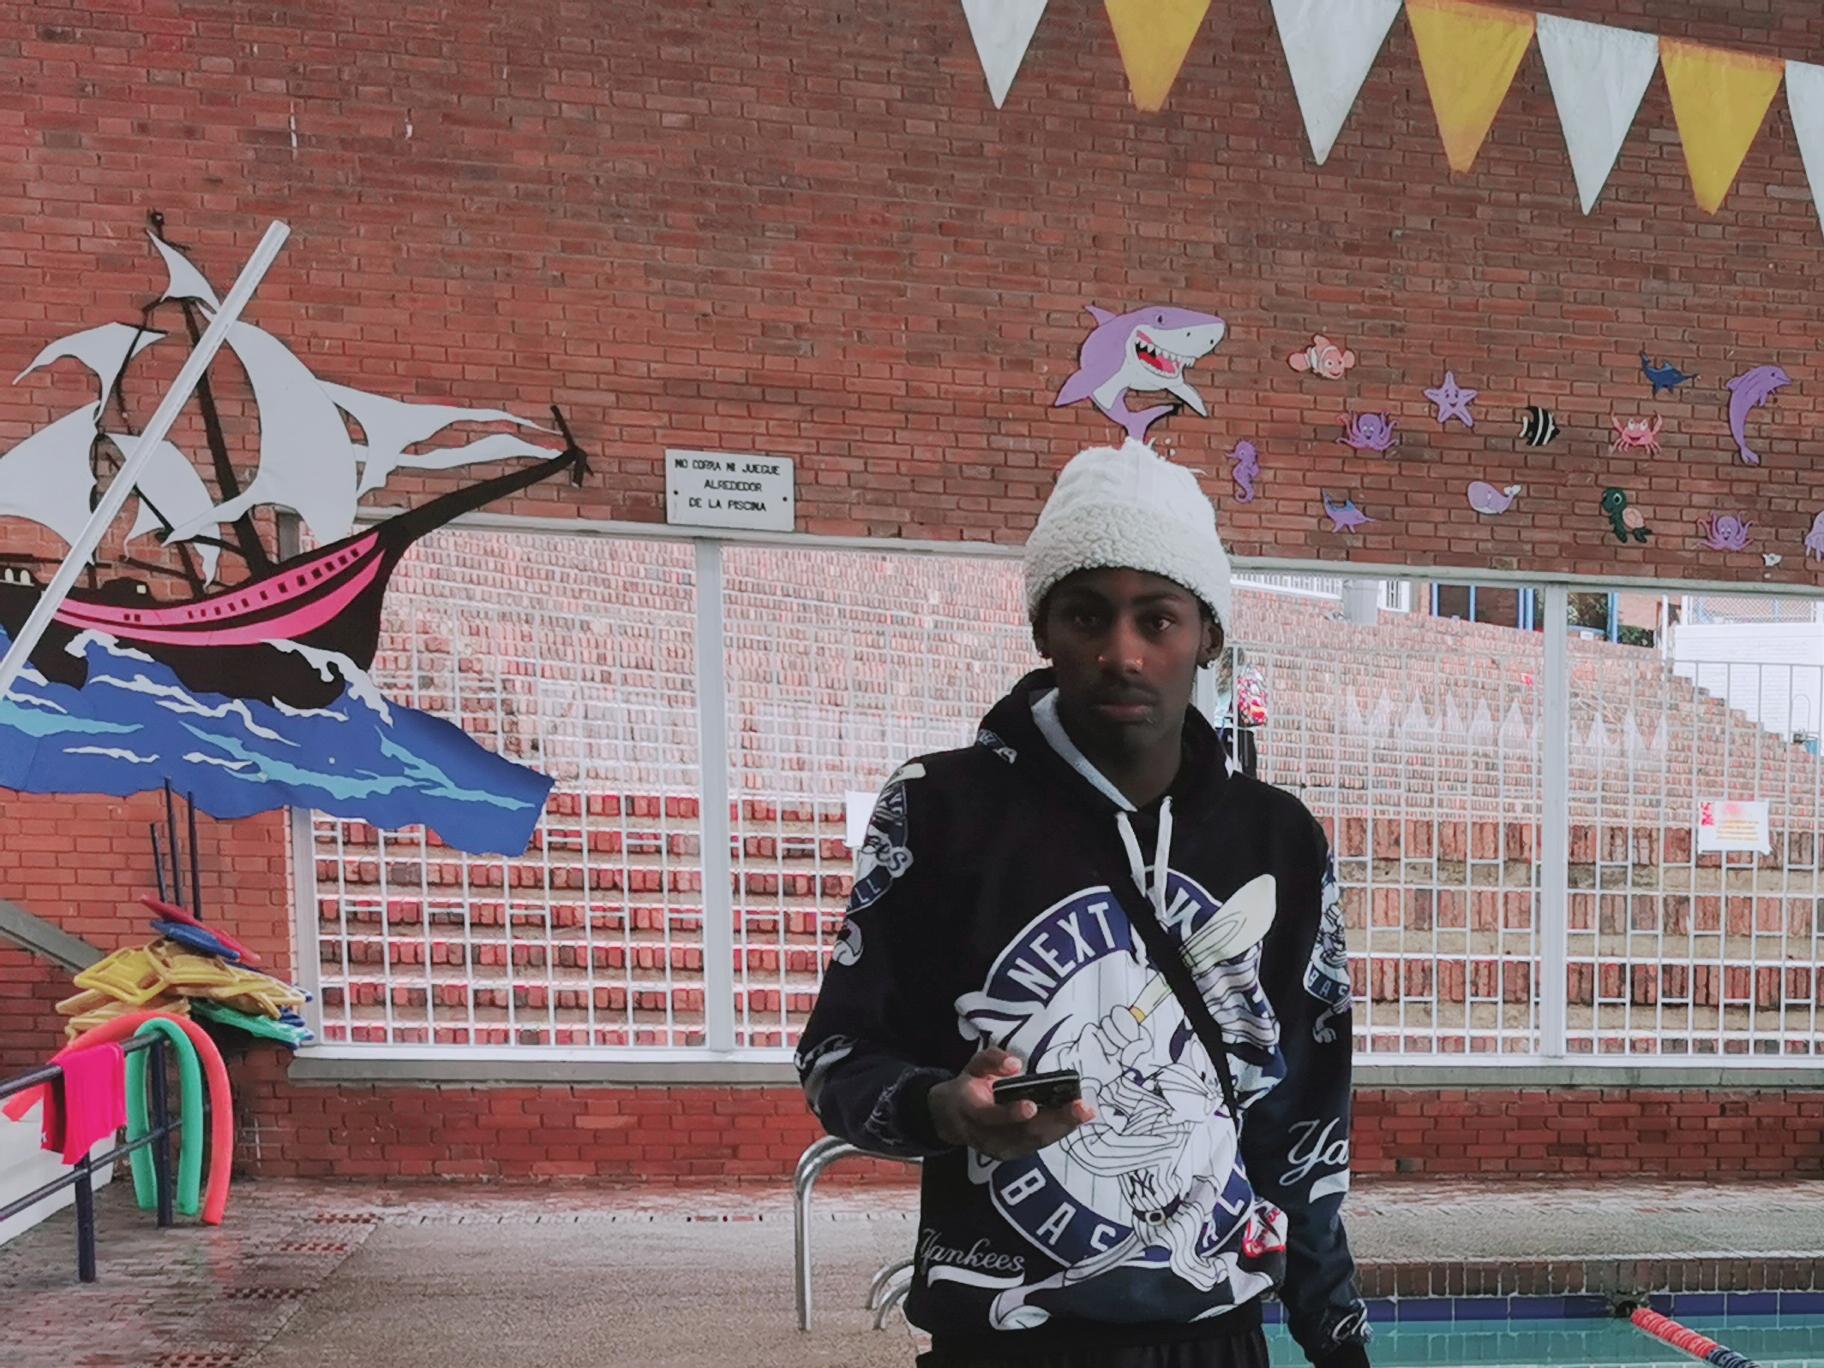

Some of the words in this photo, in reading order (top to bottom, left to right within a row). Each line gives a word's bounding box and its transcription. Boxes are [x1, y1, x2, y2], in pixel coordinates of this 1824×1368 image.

[674, 458, 689, 469] NO
[692, 459, 722, 472] CORRA
[726, 462, 736, 472] NI
[741, 463, 780, 476] JUEGUE
[703, 479, 762, 492] ALREDEDOR
[688, 497, 702, 508] DE
[708, 499, 722, 509] LA
[727, 499, 767, 512] PISCINA
[1006, 901, 1110, 1000] NEXT
[920, 1228, 1025, 1276] Yankees
